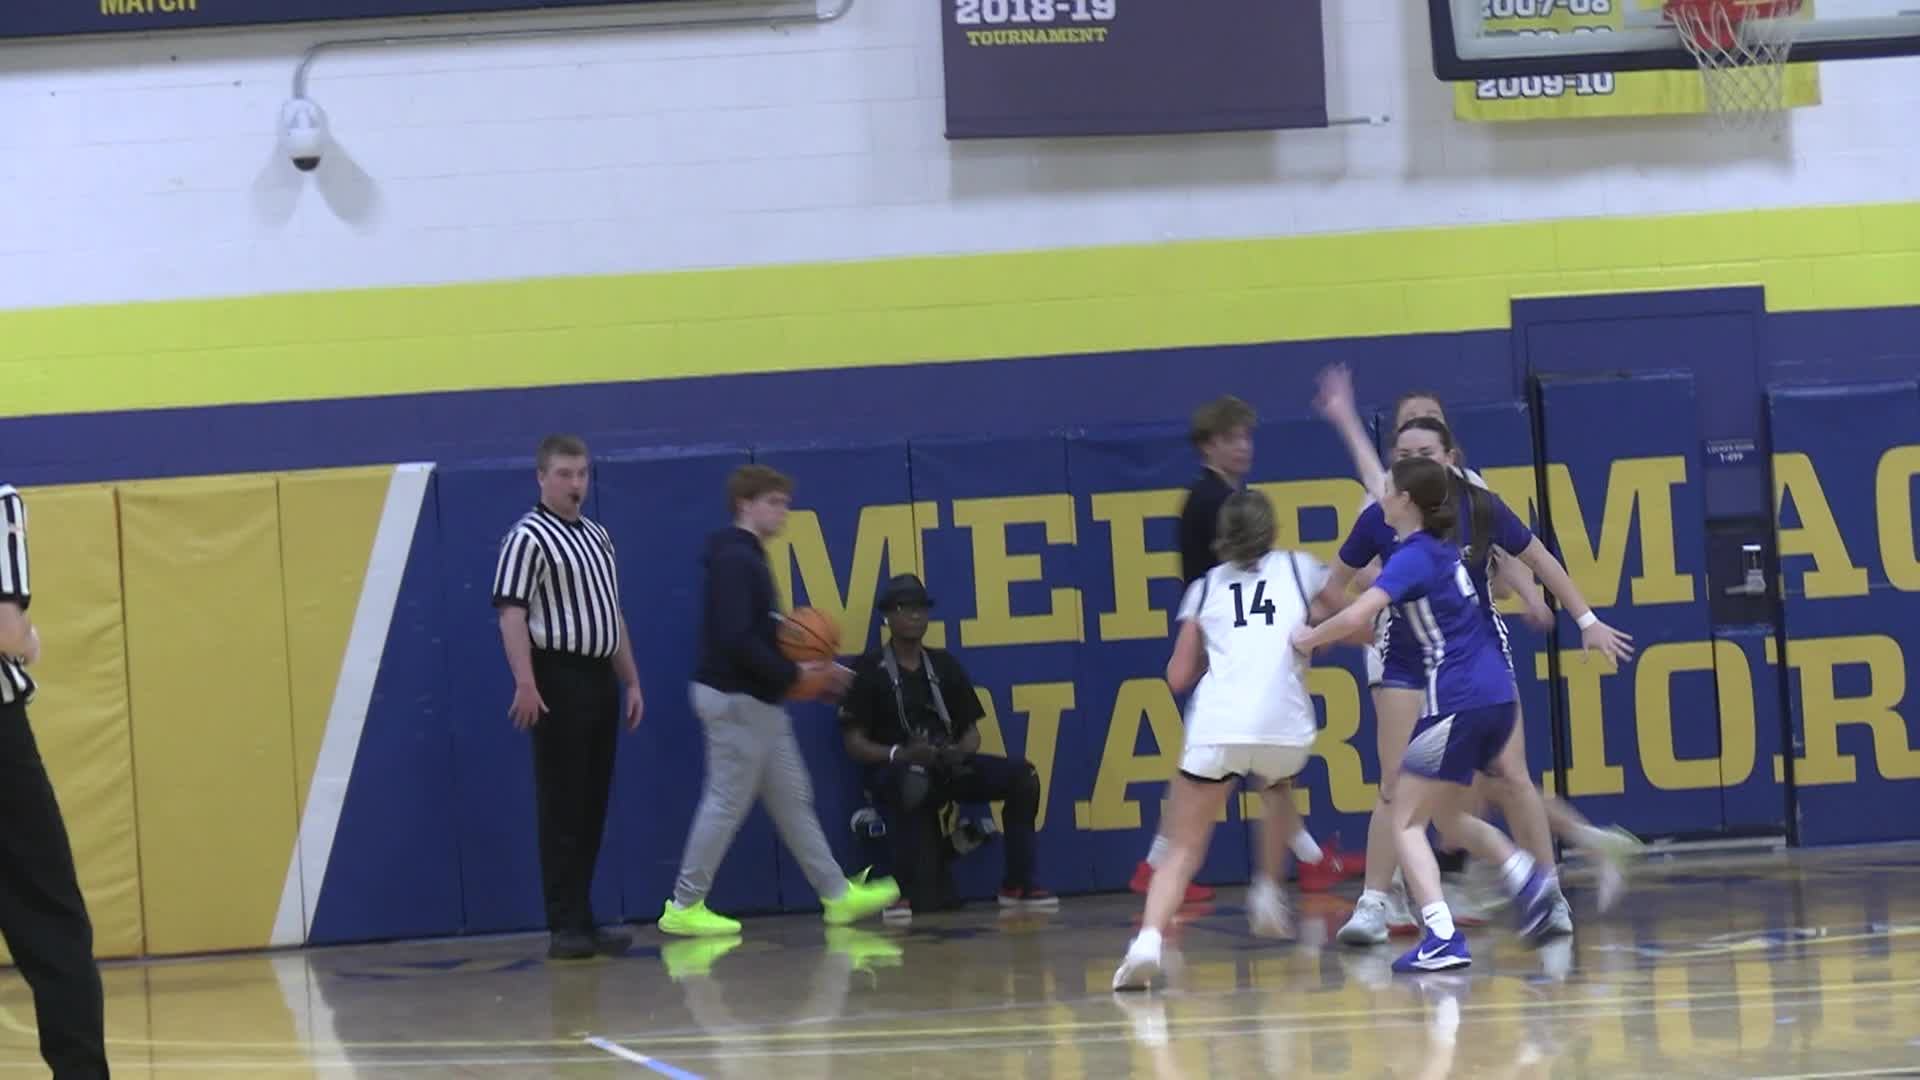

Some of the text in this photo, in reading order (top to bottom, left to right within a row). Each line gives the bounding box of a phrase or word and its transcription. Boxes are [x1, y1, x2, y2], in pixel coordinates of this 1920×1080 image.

[956, 0, 1117, 24] 2018-19
[967, 27, 1108, 47] TOURNAMENT
[1229, 579, 1276, 628] 14
